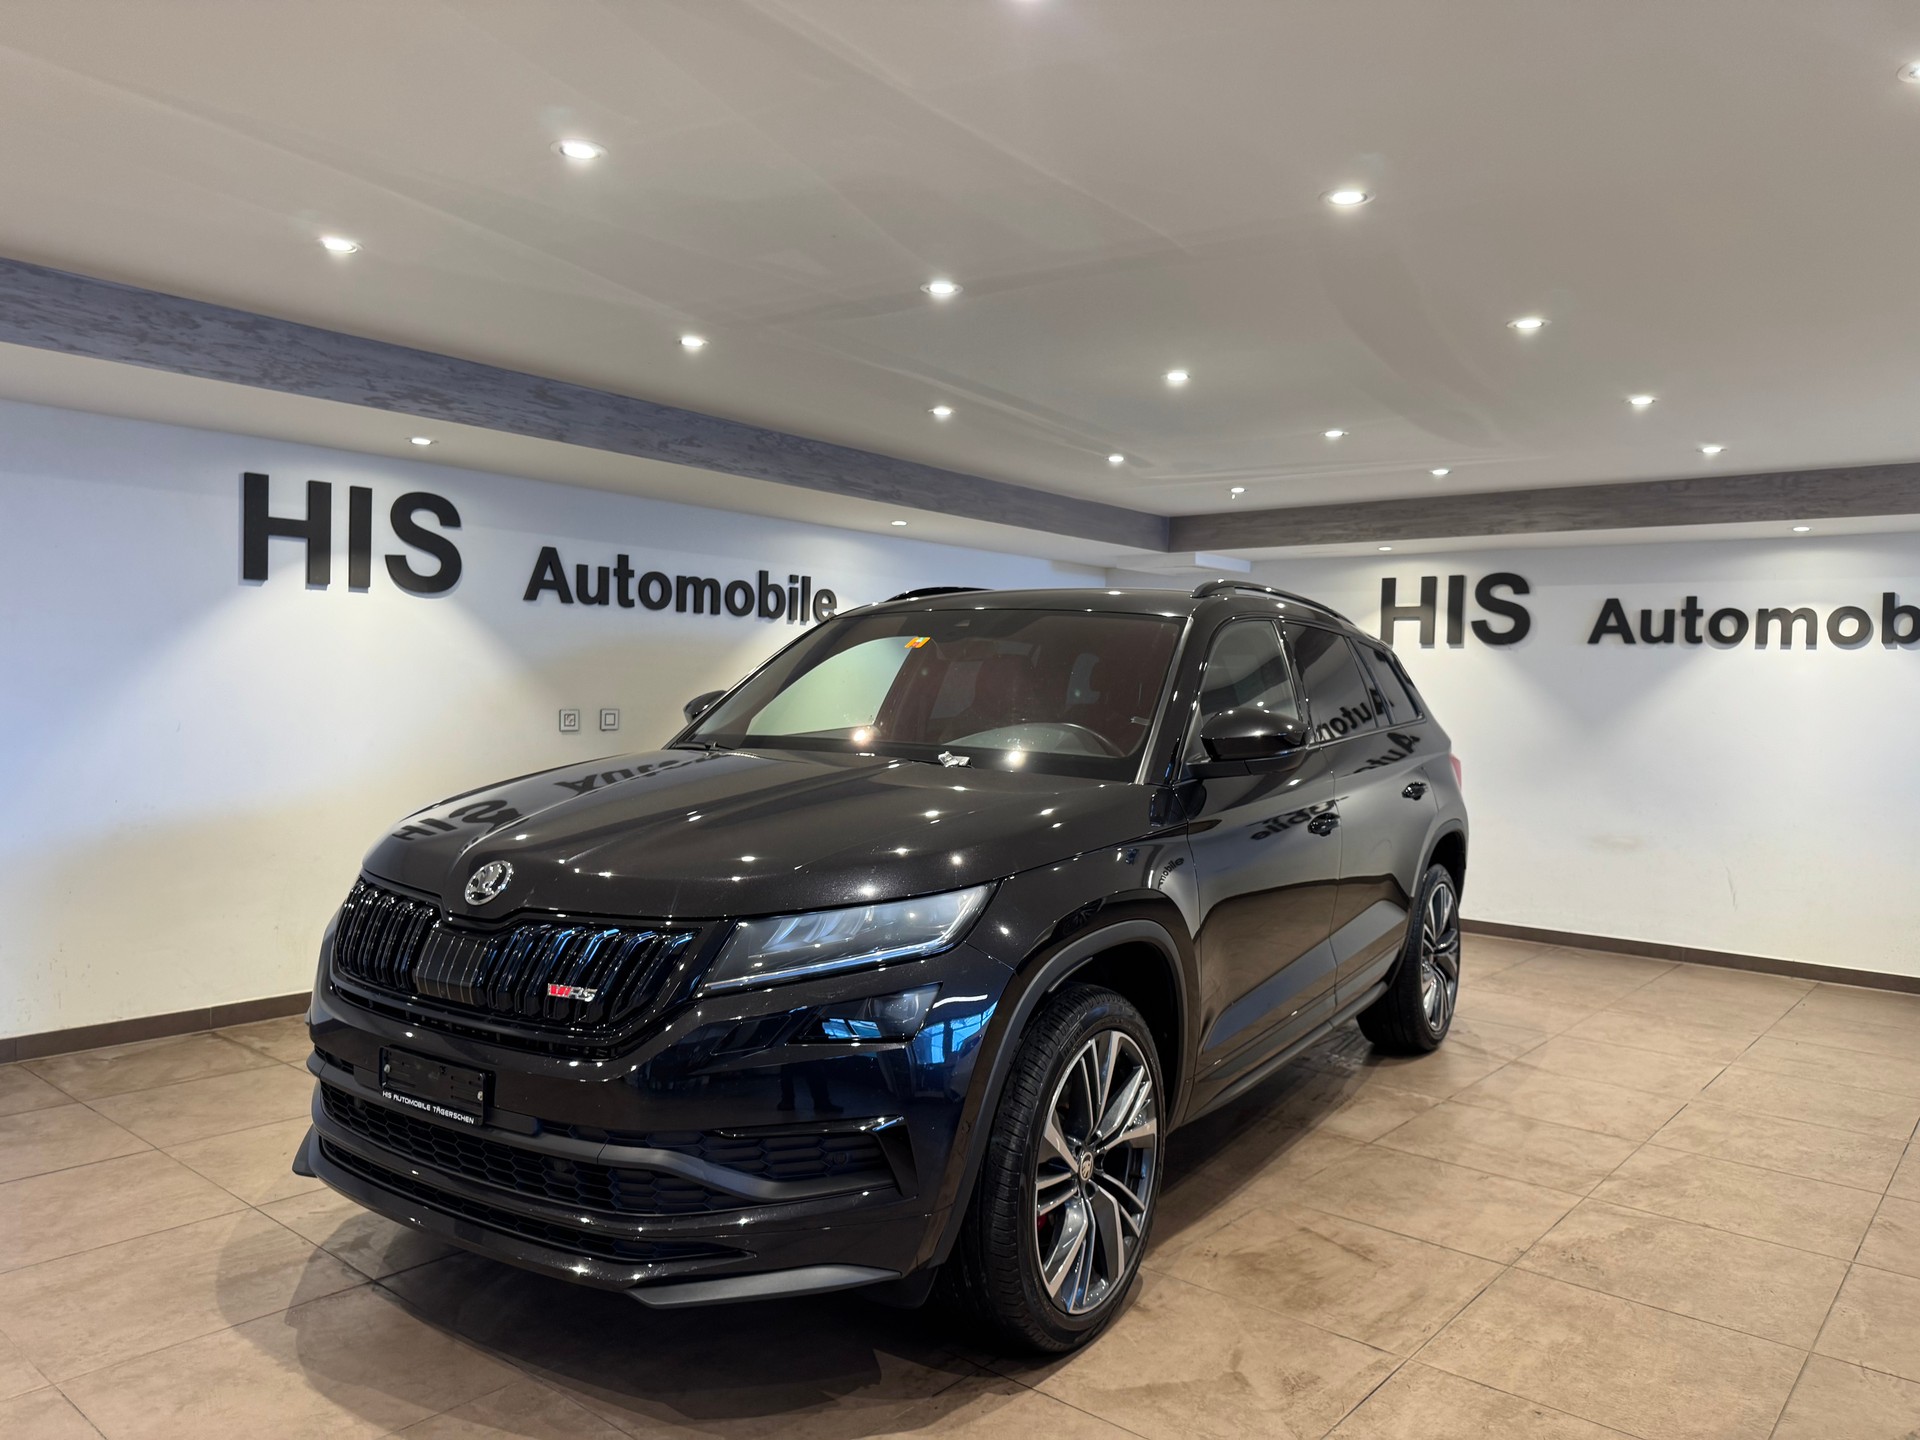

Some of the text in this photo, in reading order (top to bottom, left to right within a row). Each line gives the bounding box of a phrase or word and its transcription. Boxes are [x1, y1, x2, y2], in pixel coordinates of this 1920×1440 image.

[243, 472, 838, 624] HIS Automobile
[1380, 572, 1920, 646] HIS Automob
[382, 1090, 392, 1099] HIS
[393, 1093, 431, 1112] AUTOMOBILE
